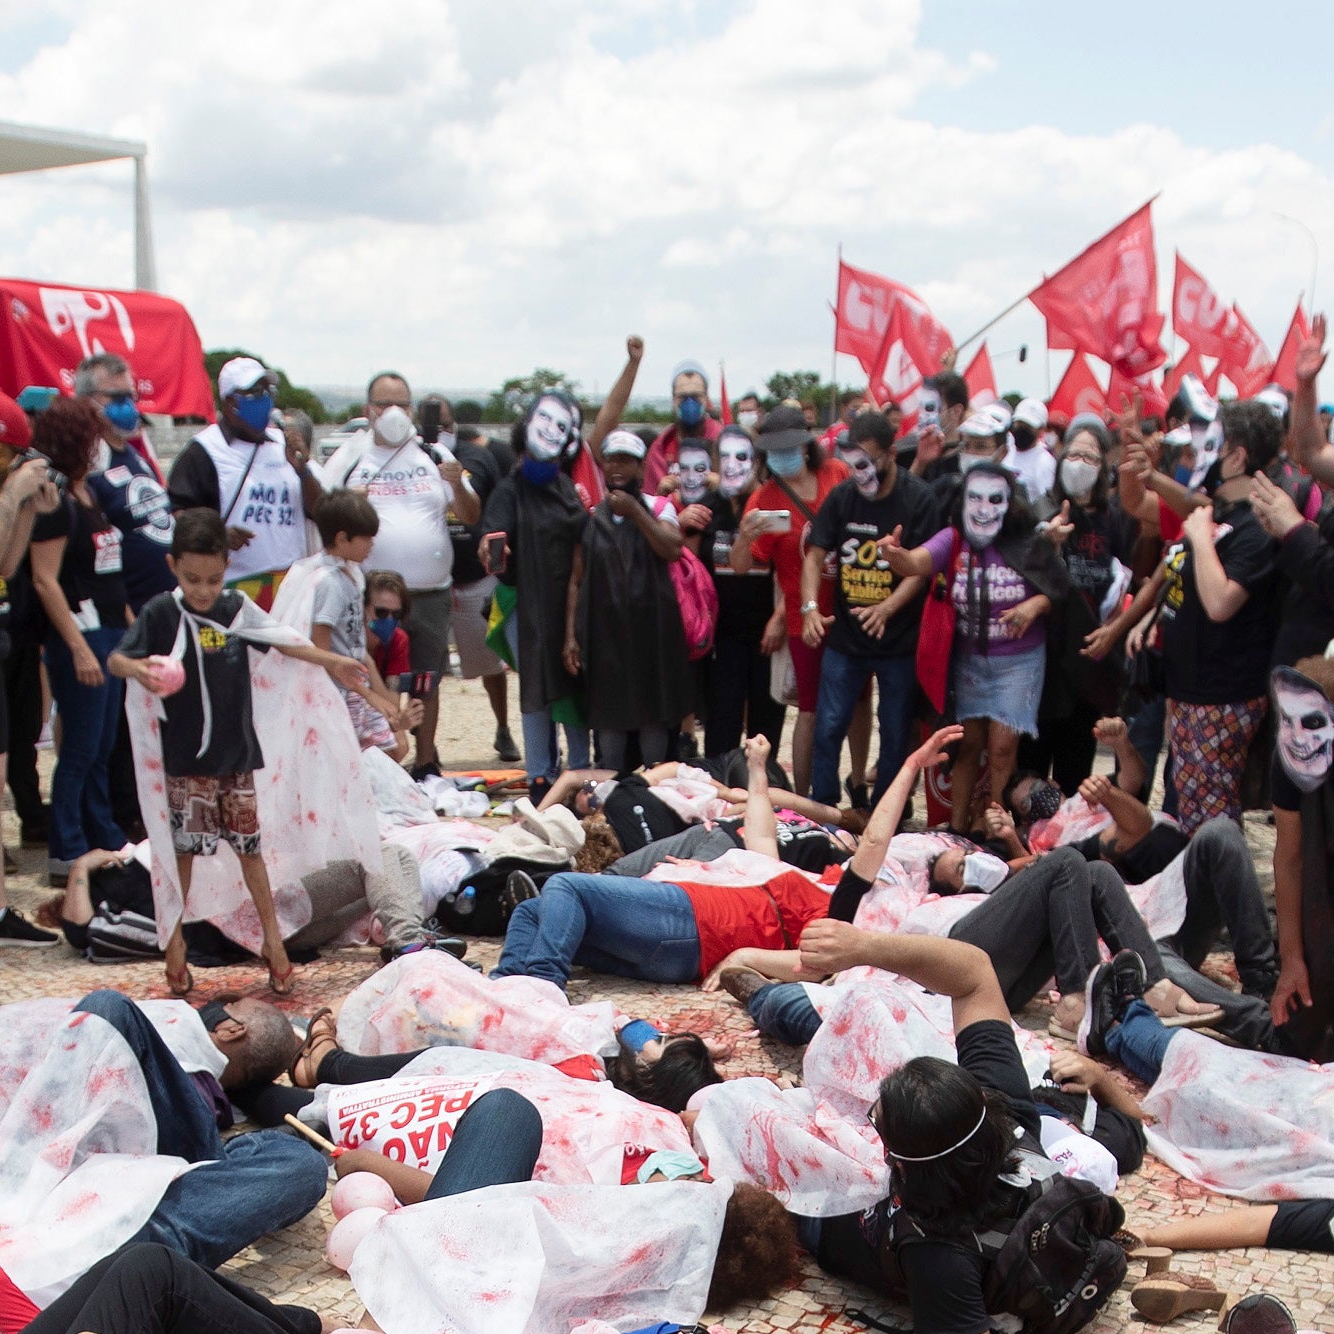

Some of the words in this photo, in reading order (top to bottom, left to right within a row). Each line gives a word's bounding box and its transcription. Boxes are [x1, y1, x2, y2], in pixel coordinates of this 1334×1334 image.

[242, 505, 272, 524] PEC
[390, 1090, 474, 1129] PEC
[339, 1111, 380, 1150] 32
[383, 1118, 460, 1169] NÃO
